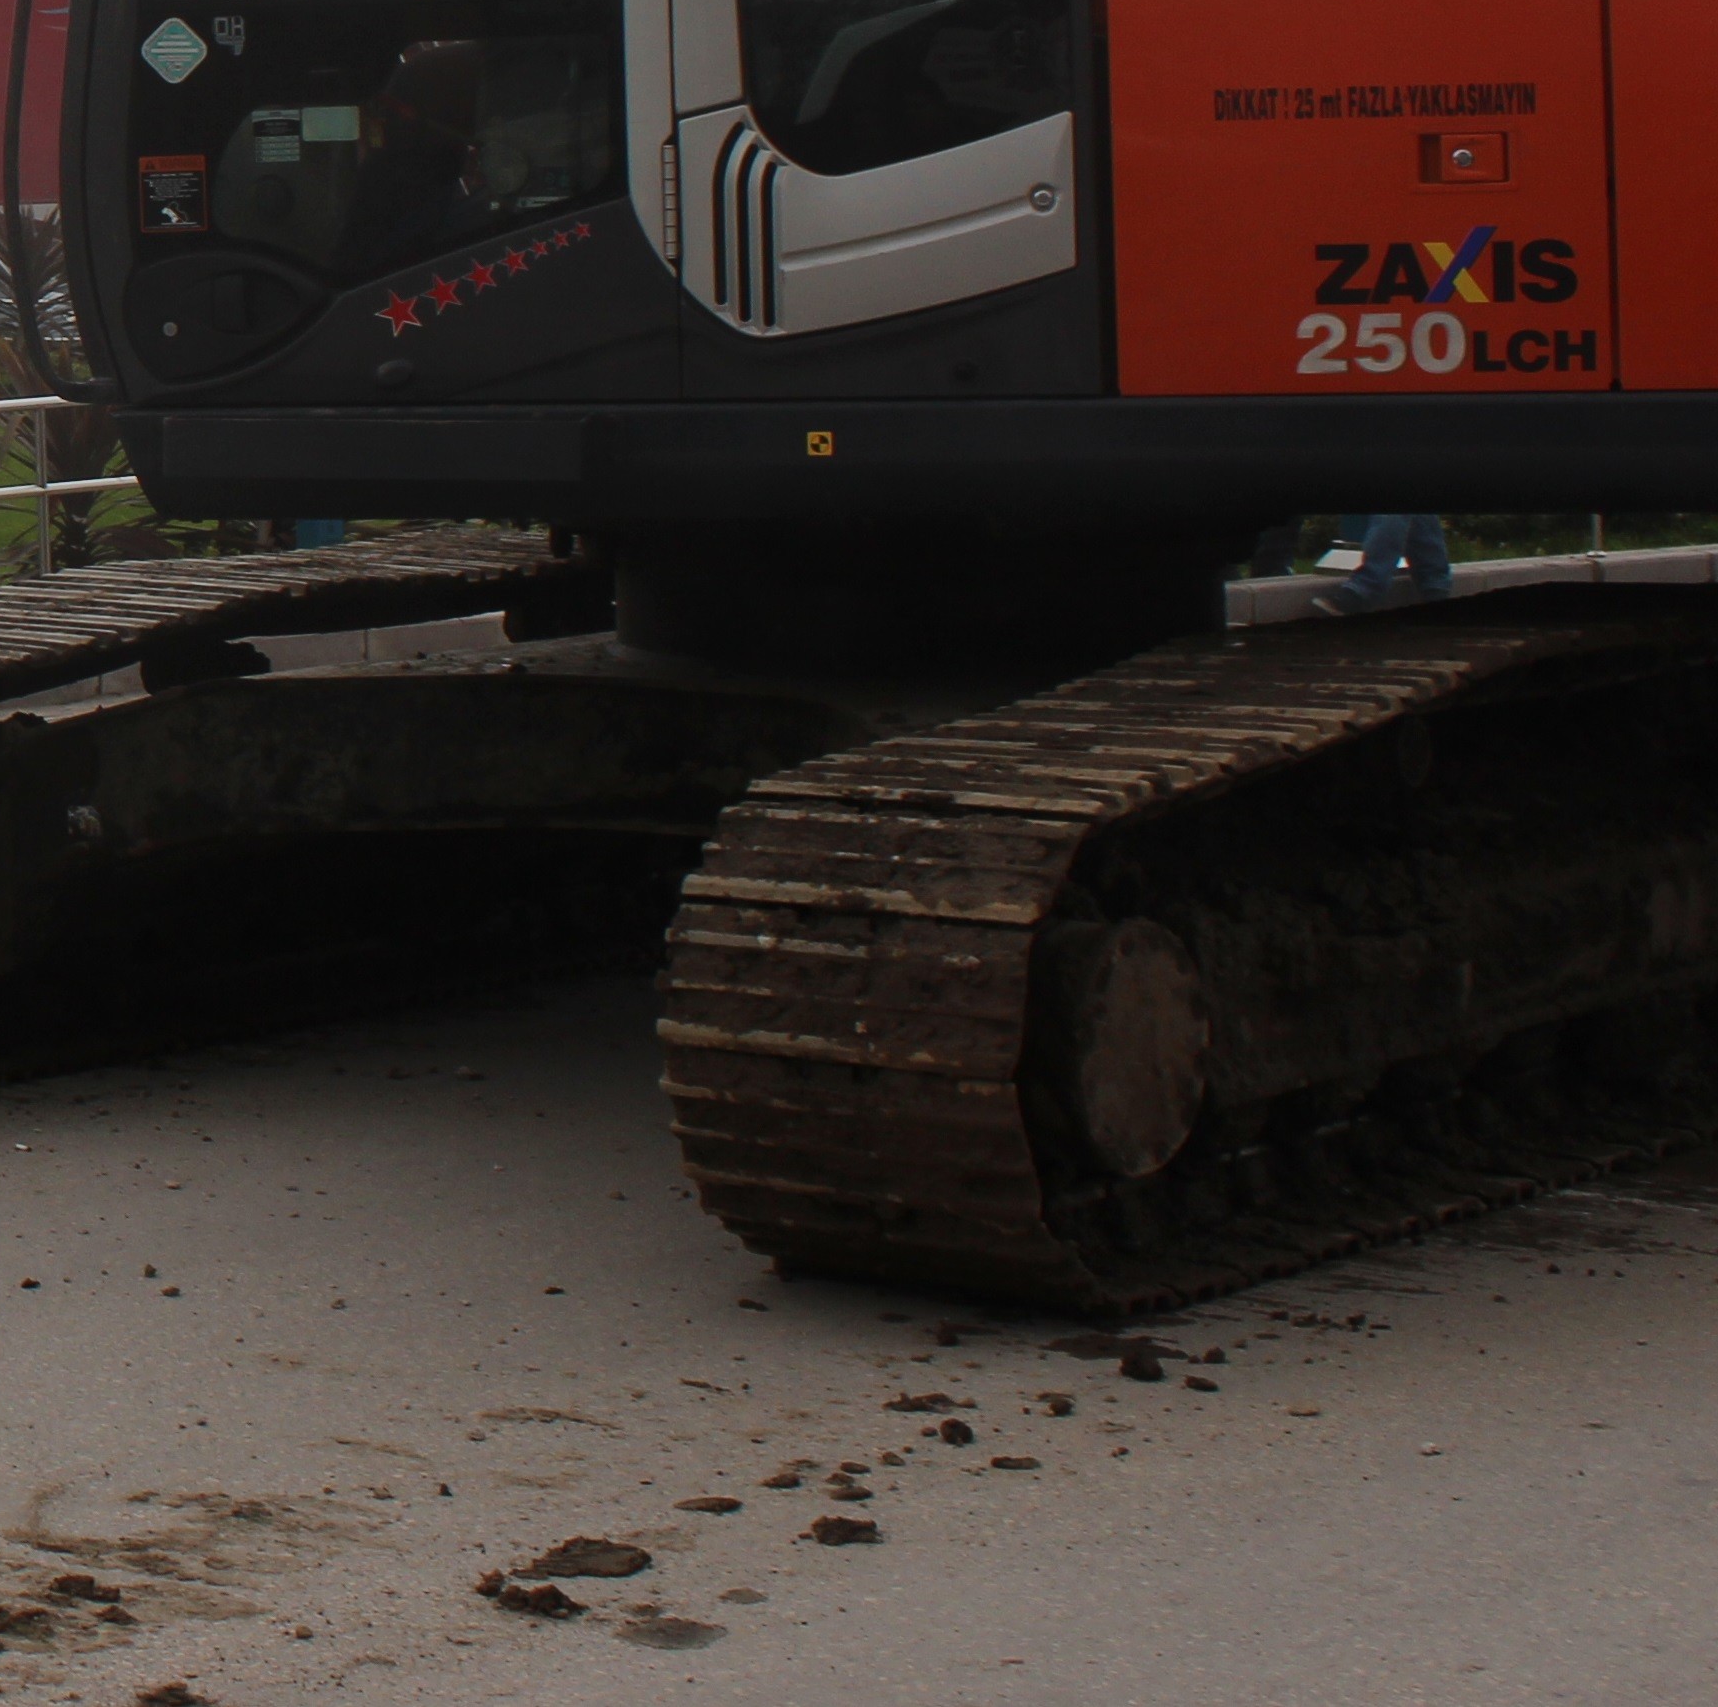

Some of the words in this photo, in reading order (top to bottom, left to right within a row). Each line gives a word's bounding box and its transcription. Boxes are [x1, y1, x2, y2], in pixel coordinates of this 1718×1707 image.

[1294, 87, 1314, 119] 25
[1320, 87, 1342, 119] mt
[1348, 86, 1404, 118] FAZLA
[1316, 225, 1578, 305] ZAXIS
